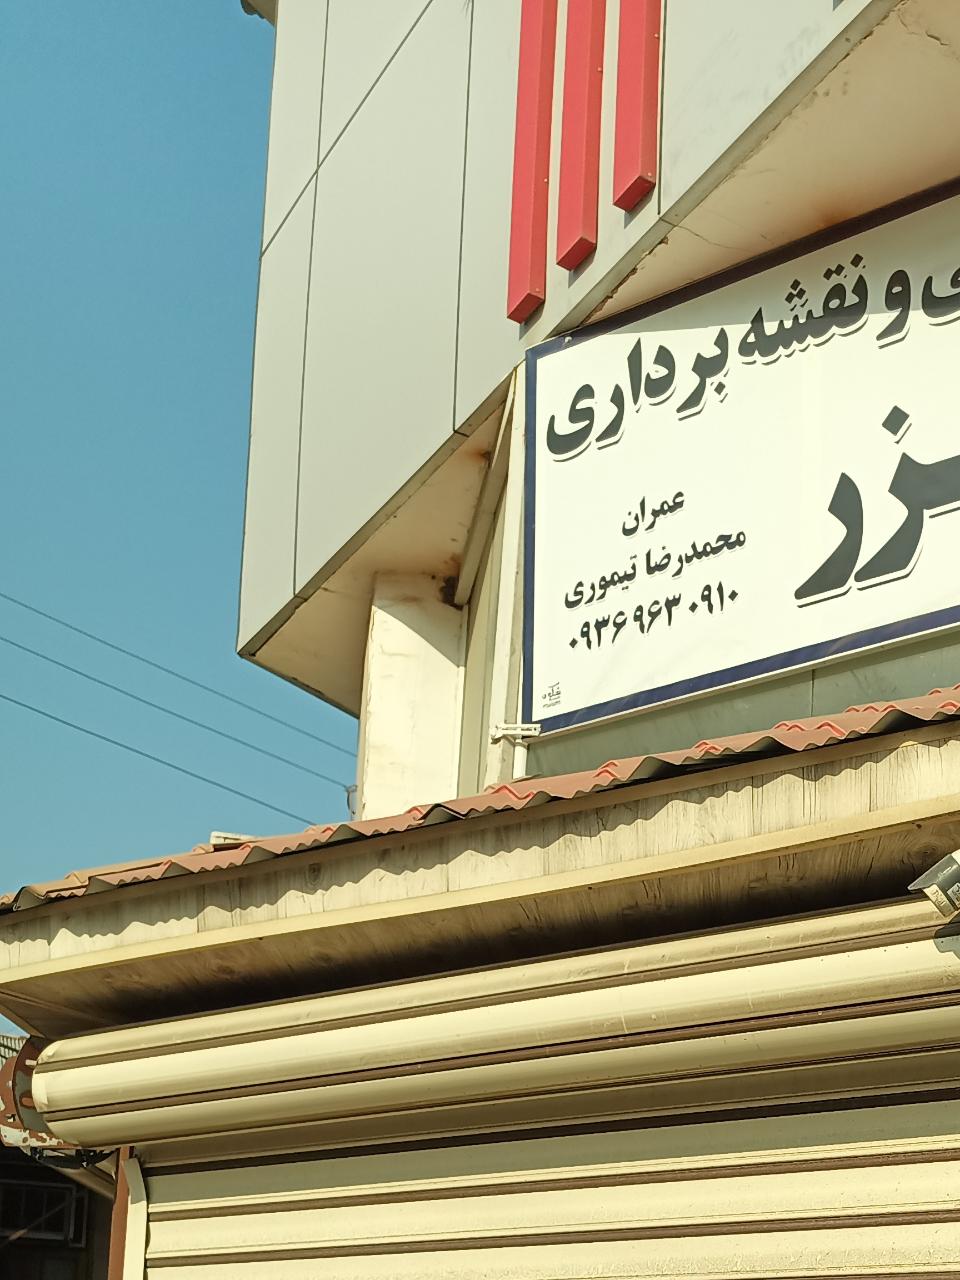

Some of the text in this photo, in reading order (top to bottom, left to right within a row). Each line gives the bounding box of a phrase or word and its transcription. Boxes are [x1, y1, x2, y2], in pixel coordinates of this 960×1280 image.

[738, 254, 868, 365] نقشه
[877, 269, 912, 347] و
[546, 332, 730, 462] برداری
[622, 490, 685, 537] عمران
[564, 530, 746, 611] محمدرضا تیموری
